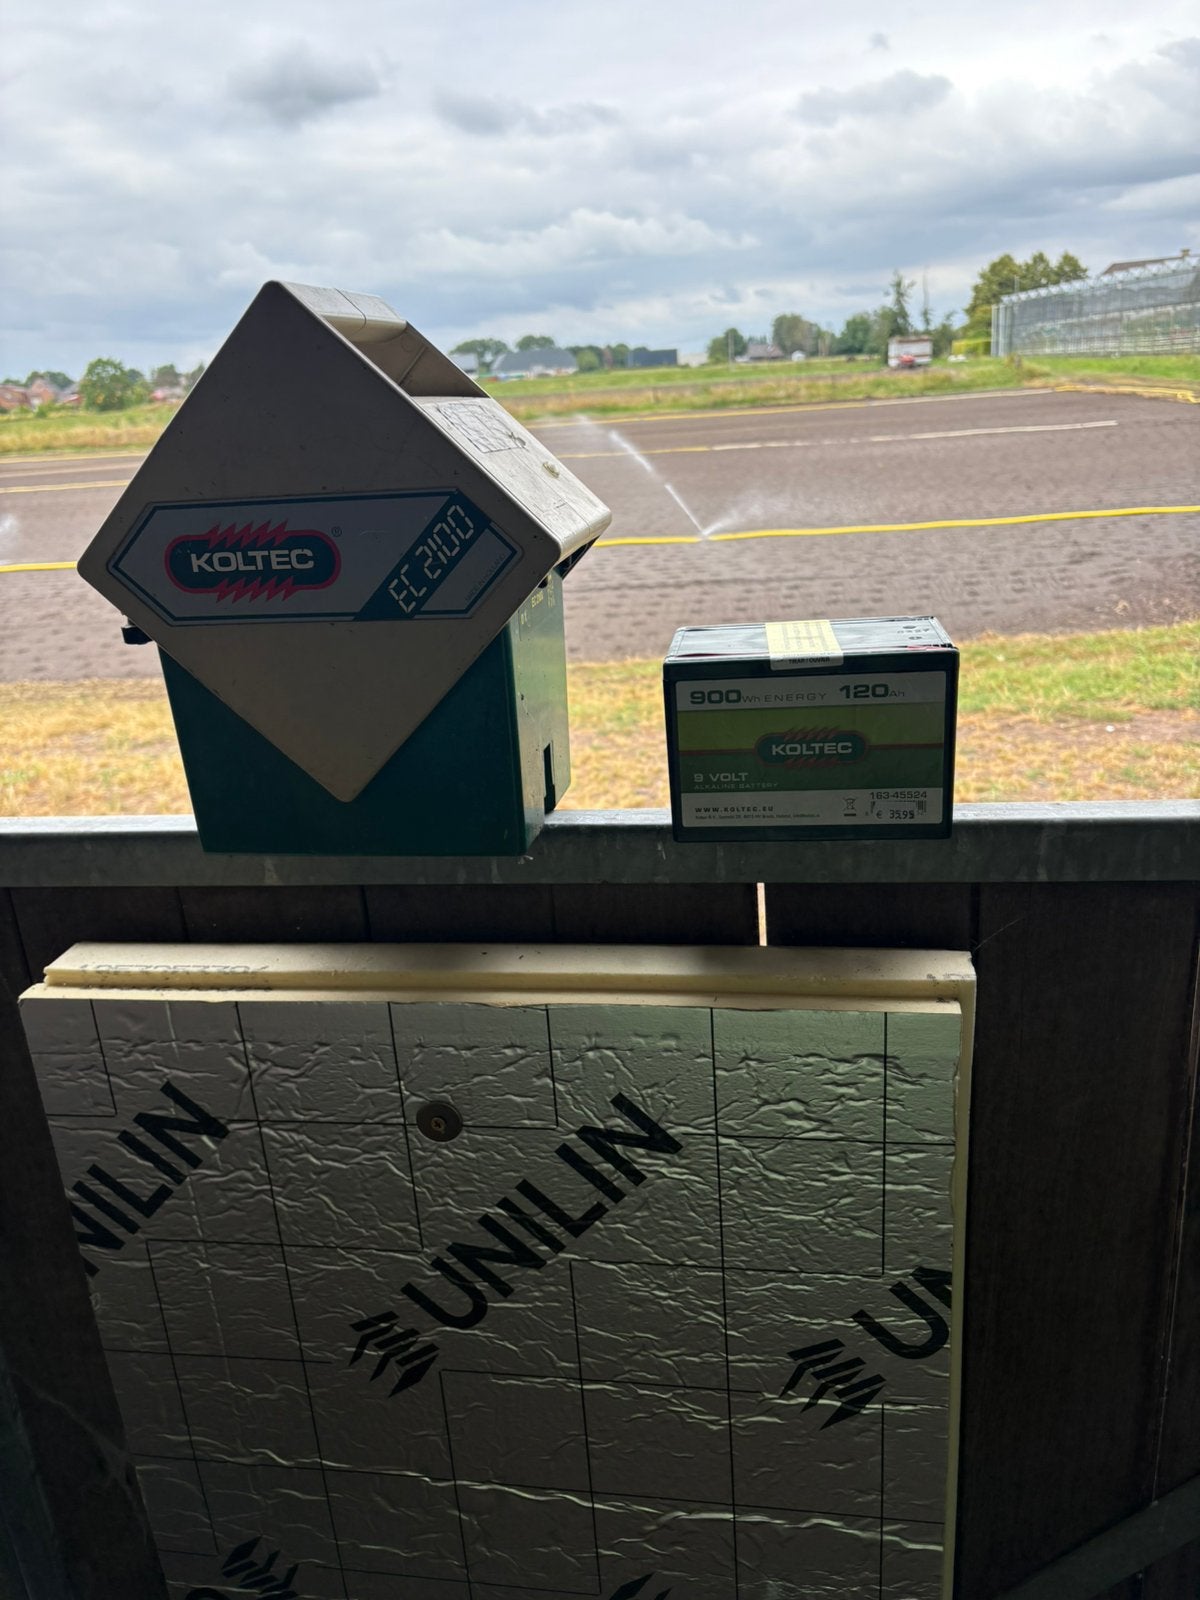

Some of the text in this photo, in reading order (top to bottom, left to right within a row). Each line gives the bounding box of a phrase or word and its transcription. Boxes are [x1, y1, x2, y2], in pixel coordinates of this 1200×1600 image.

[190, 547, 315, 574] KOLTEC
[388, 504, 474, 614] EC 2100
[764, 692, 827, 703] ENERGY
[771, 741, 853, 756] KOLTEC
[709, 772, 749, 782] VOLT
[870, 791, 928, 800] 163-45524
[400, 1092, 683, 1330] UNILIN
